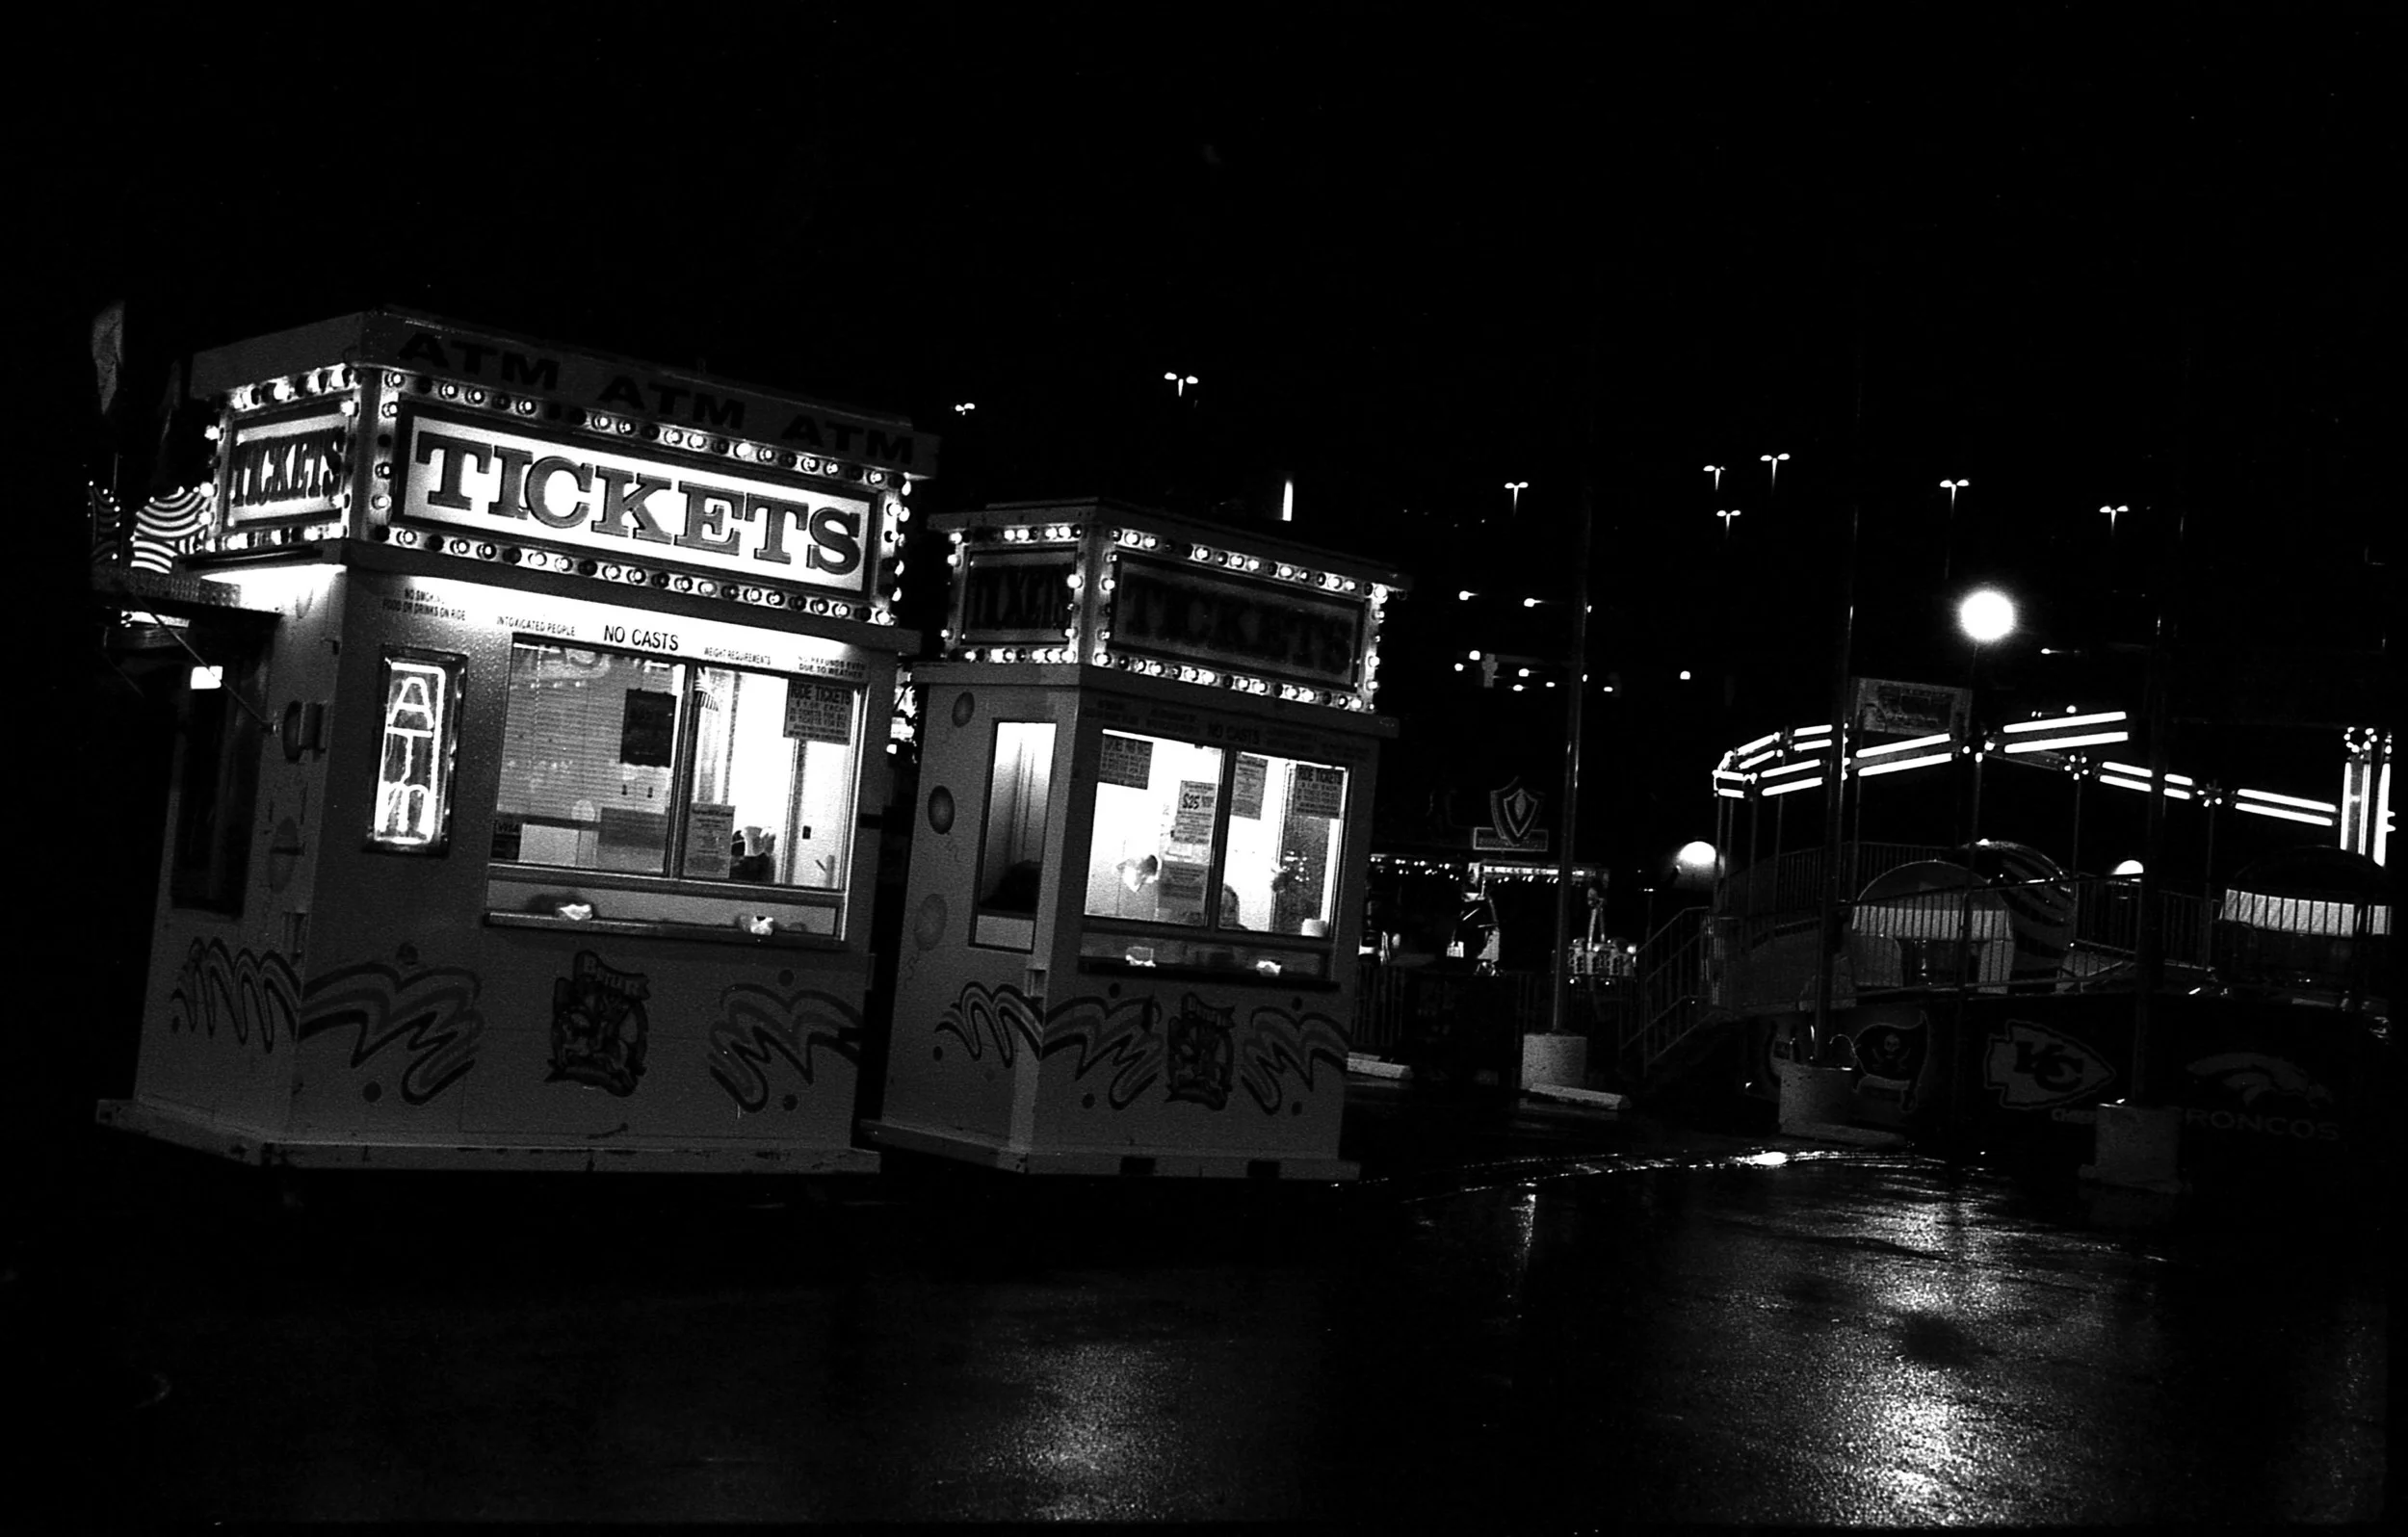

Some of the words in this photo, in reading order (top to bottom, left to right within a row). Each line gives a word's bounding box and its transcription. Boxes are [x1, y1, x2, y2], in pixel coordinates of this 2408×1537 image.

[398, 331, 559, 388] ATM
[598, 375, 746, 430] ATM
[779, 414, 916, 464] ATM
[231, 426, 345, 508] TICKETS
[417, 431, 863, 576] TICKETS
[496, 614, 545, 633] INTOXICATED
[546, 621, 576, 637] PEOPLE
[603, 624, 626, 644] NO
[631, 628, 680, 652] CASTS
[1122, 573, 1353, 675] TICKETS
[815, 686, 852, 705] TICKETS
[1182, 793, 1201, 810] $25
[2185, 1107, 2340, 1141] RONCOS
